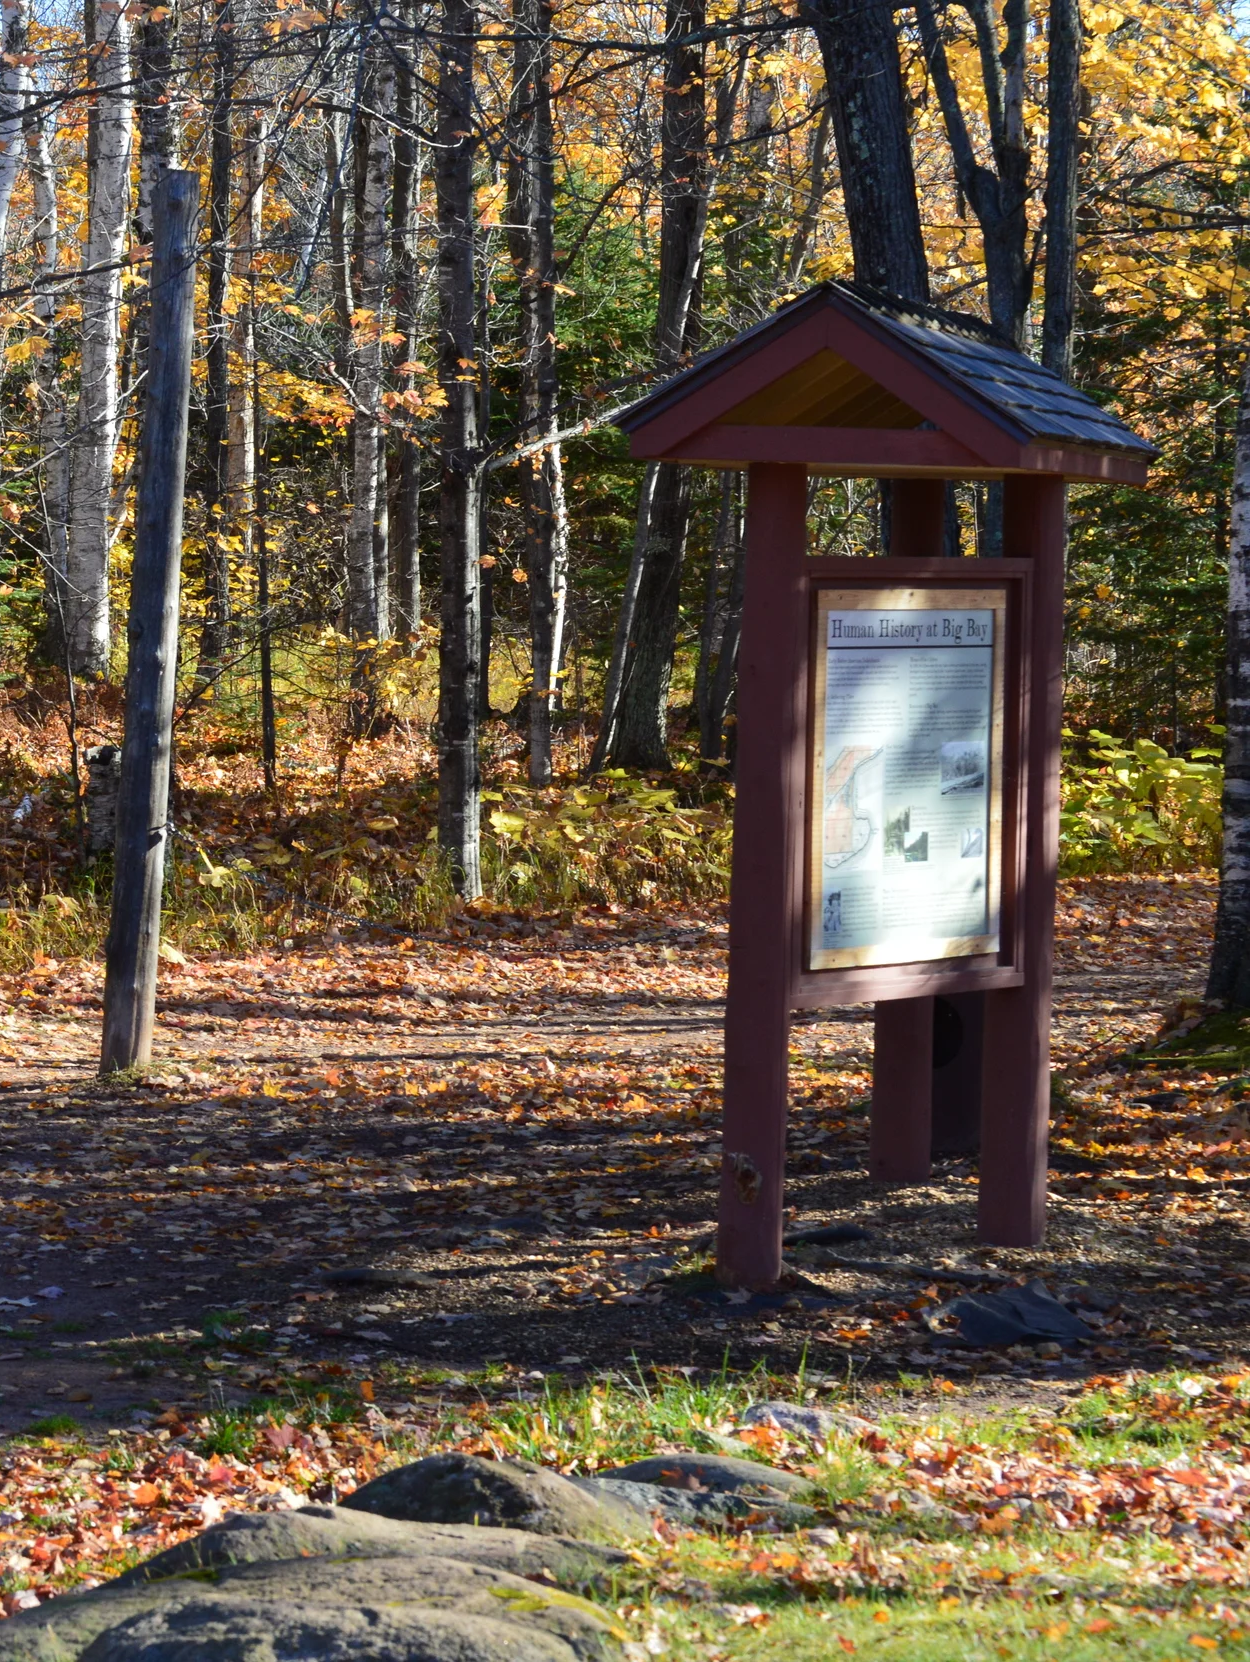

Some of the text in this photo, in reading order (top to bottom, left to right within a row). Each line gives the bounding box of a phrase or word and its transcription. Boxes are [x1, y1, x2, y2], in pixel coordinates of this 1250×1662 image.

[832, 618, 988, 644] Human History at Big Bay
